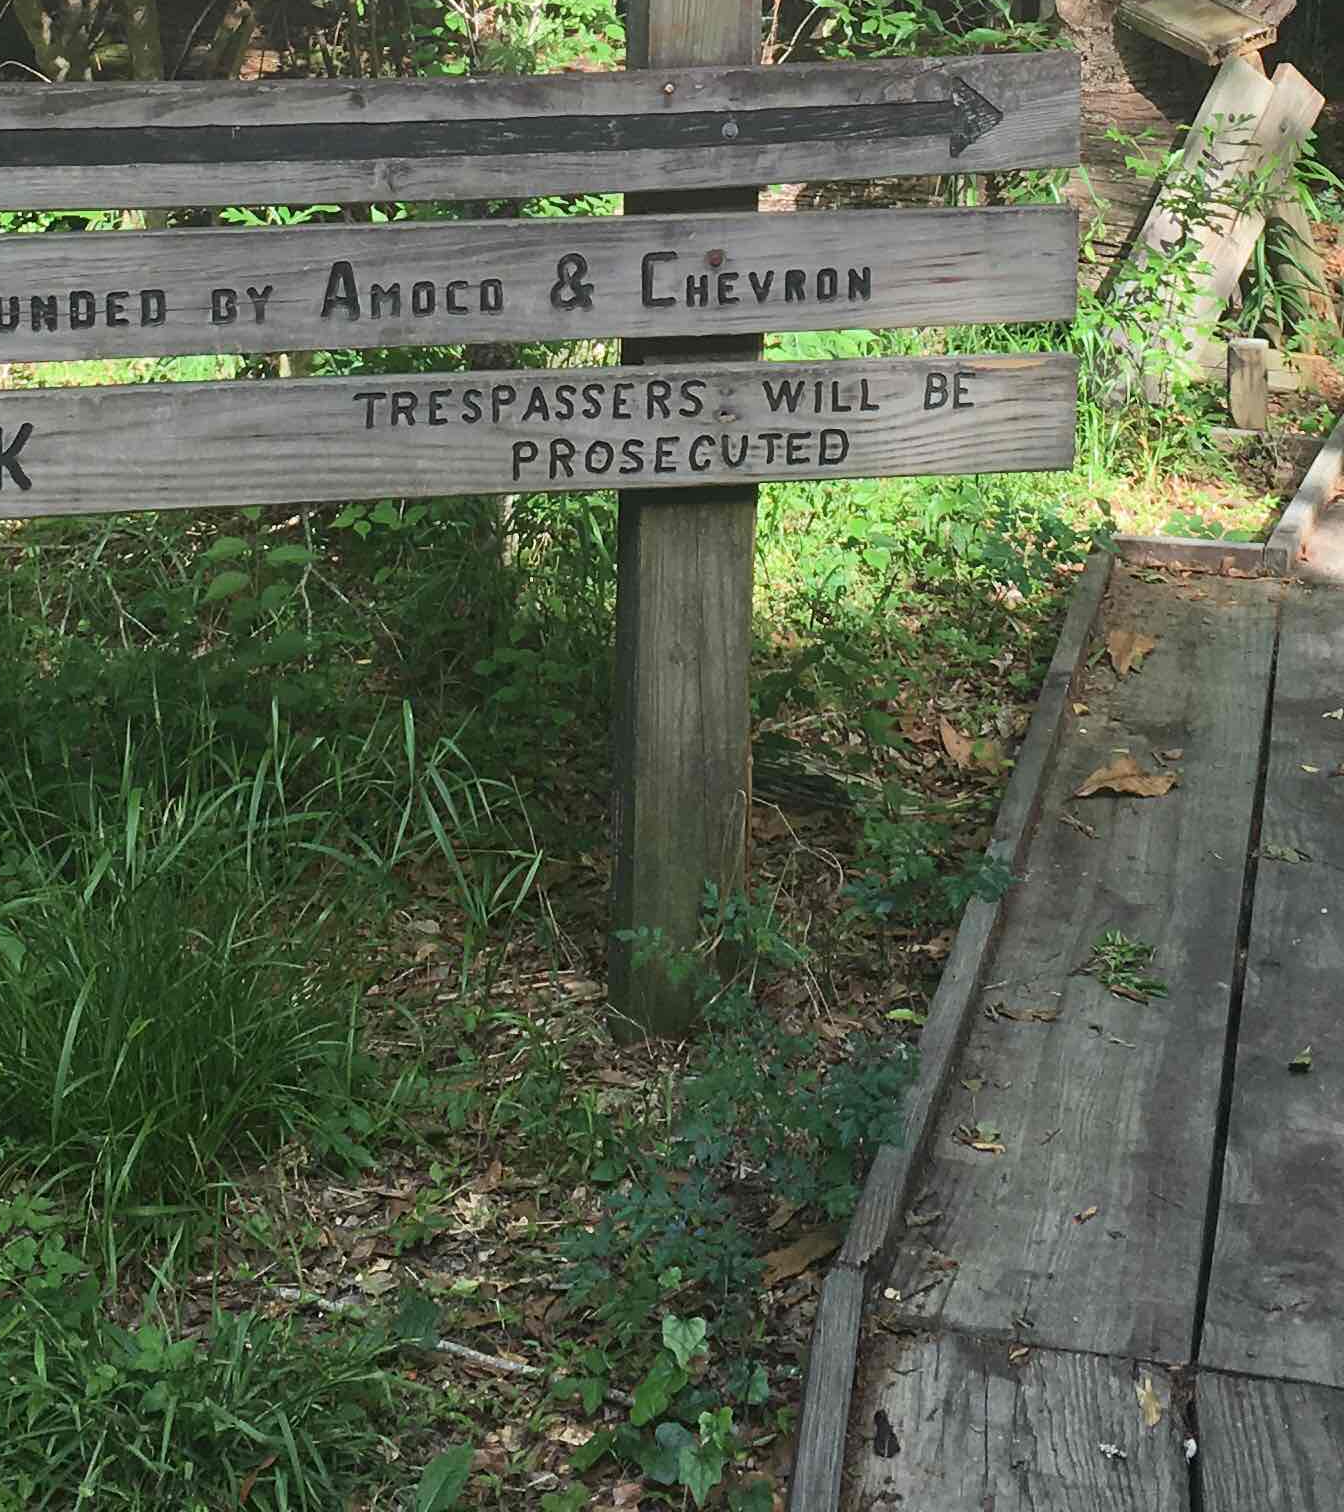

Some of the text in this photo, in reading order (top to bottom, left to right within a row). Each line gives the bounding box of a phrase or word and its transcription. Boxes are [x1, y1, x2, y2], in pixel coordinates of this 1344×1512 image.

[211, 284, 274, 325] BY
[549, 252, 596, 312] &
[353, 371, 977, 429] TRESPASSERS WILL BE
[512, 428, 850, 482] PROSECUTED
